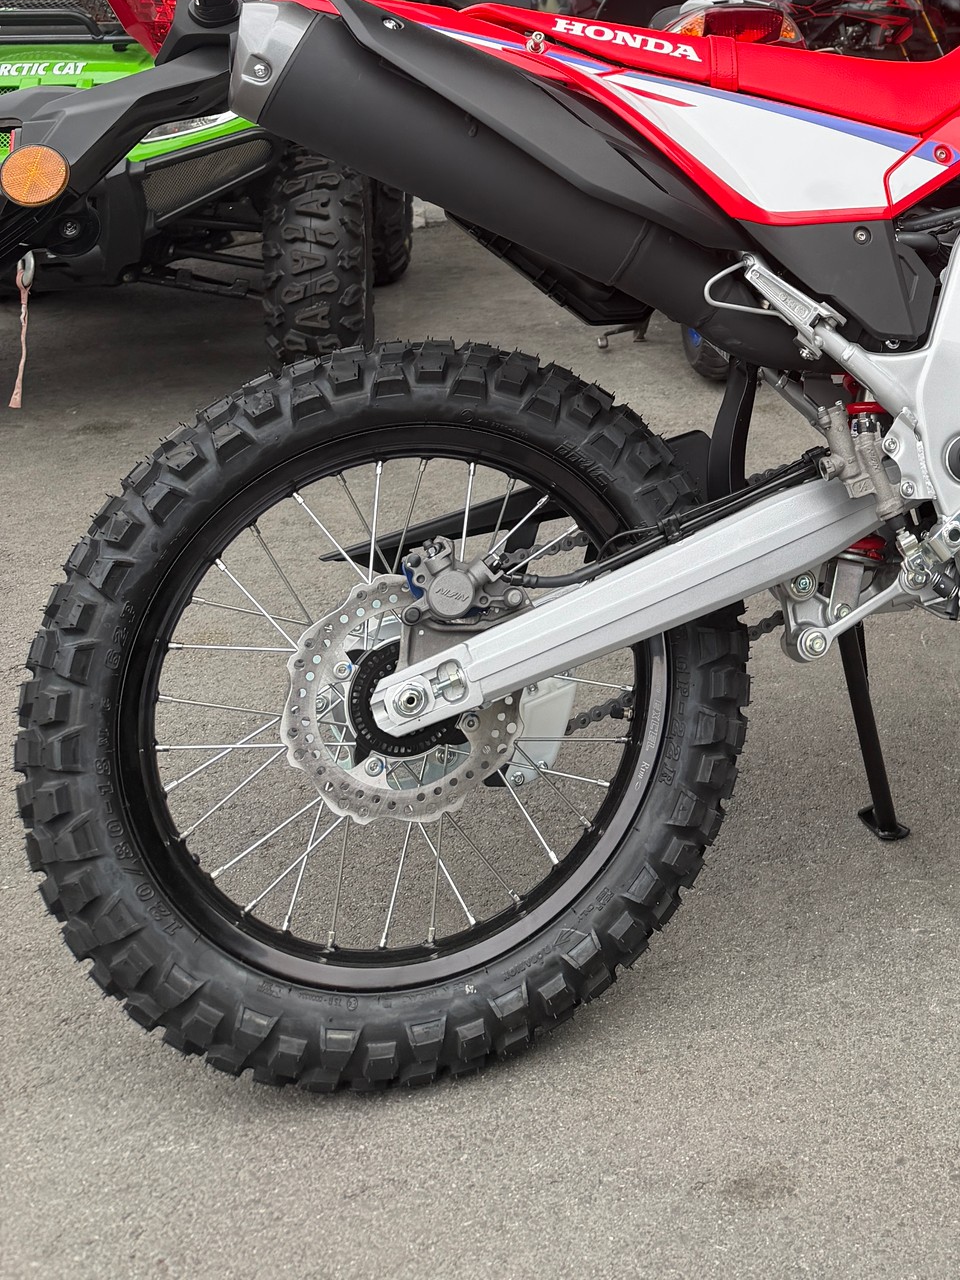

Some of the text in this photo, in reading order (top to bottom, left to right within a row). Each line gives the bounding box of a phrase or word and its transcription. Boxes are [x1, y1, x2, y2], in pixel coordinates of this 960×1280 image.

[551, 18, 702, 62] HONDA
[0, 62, 87, 76] RCTIC CAT
